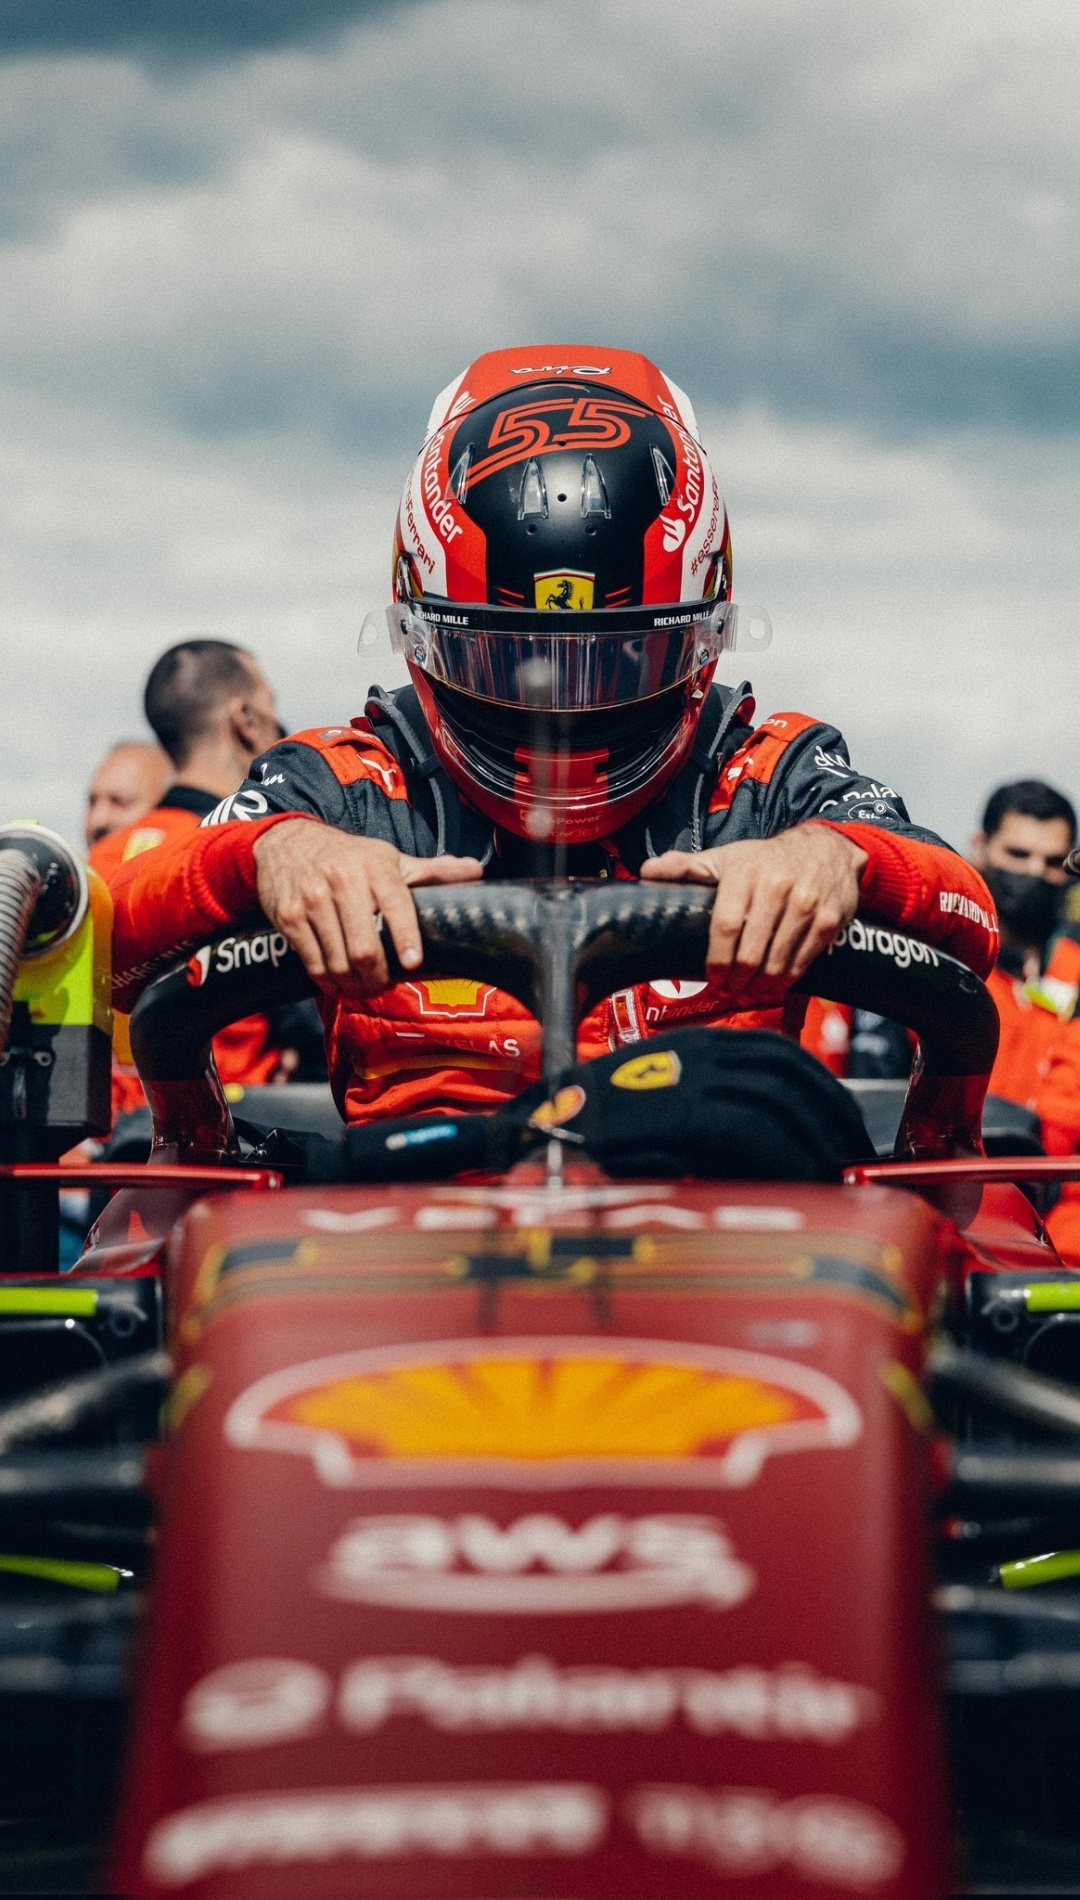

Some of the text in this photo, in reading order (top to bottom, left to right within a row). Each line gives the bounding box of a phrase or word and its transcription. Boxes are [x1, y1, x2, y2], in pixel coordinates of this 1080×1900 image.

[466, 397, 654, 490] 55
[657, 394, 701, 523] Santander
[424, 417, 463, 543] Santander
[442, 614, 469, 625] MILLE
[654, 614, 691, 627] RICHARD
[646, 1000, 719, 1022] ntander
